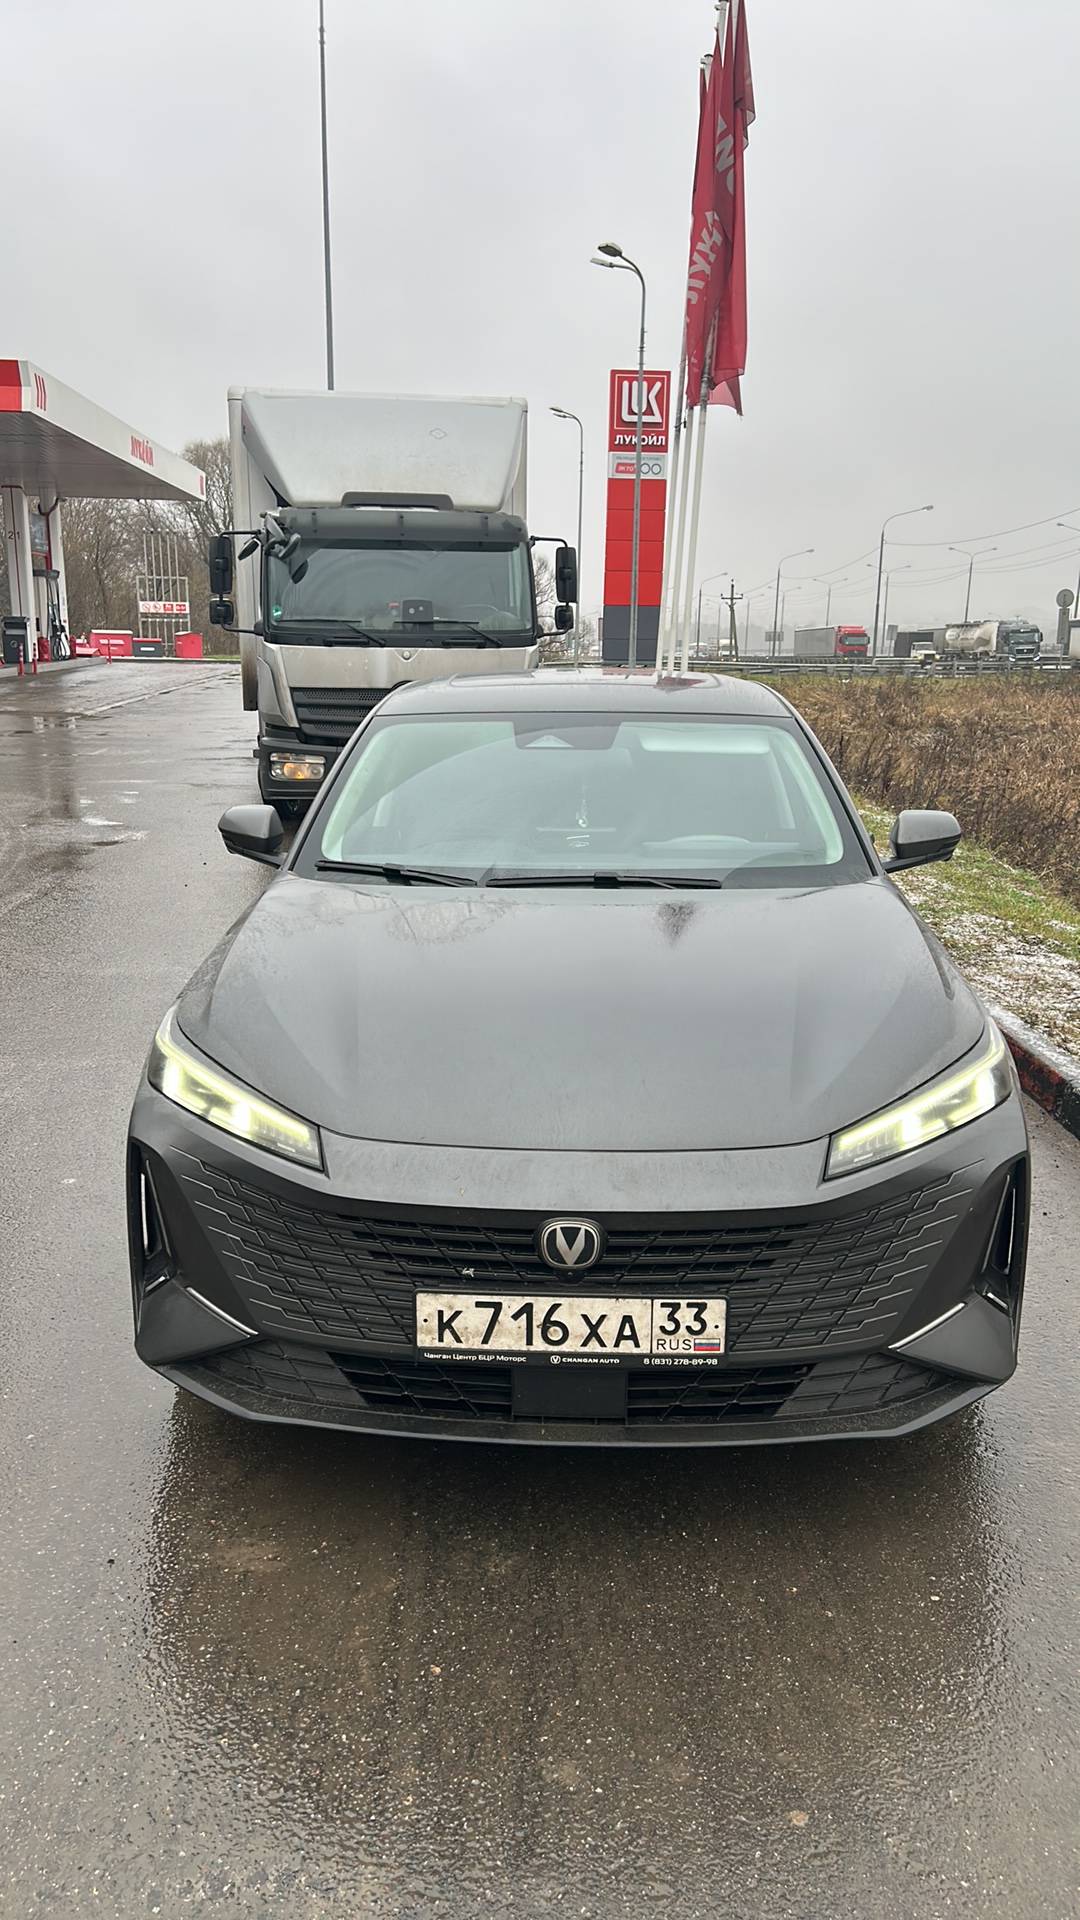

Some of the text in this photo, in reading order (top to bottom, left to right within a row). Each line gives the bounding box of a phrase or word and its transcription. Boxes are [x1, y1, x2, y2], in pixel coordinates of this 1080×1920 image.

[613, 433, 666, 445] ЛУКОЙЛ
[437, 1301, 641, 1349] К716ХА
[659, 1302, 708, 1337] 33
[656, 1338, 692, 1351] RUS
[424, 1352, 527, 1363] Чанган Центр БЦР Моторс
[643, 1357, 718, 1366] 8 (831) 278-89-98
